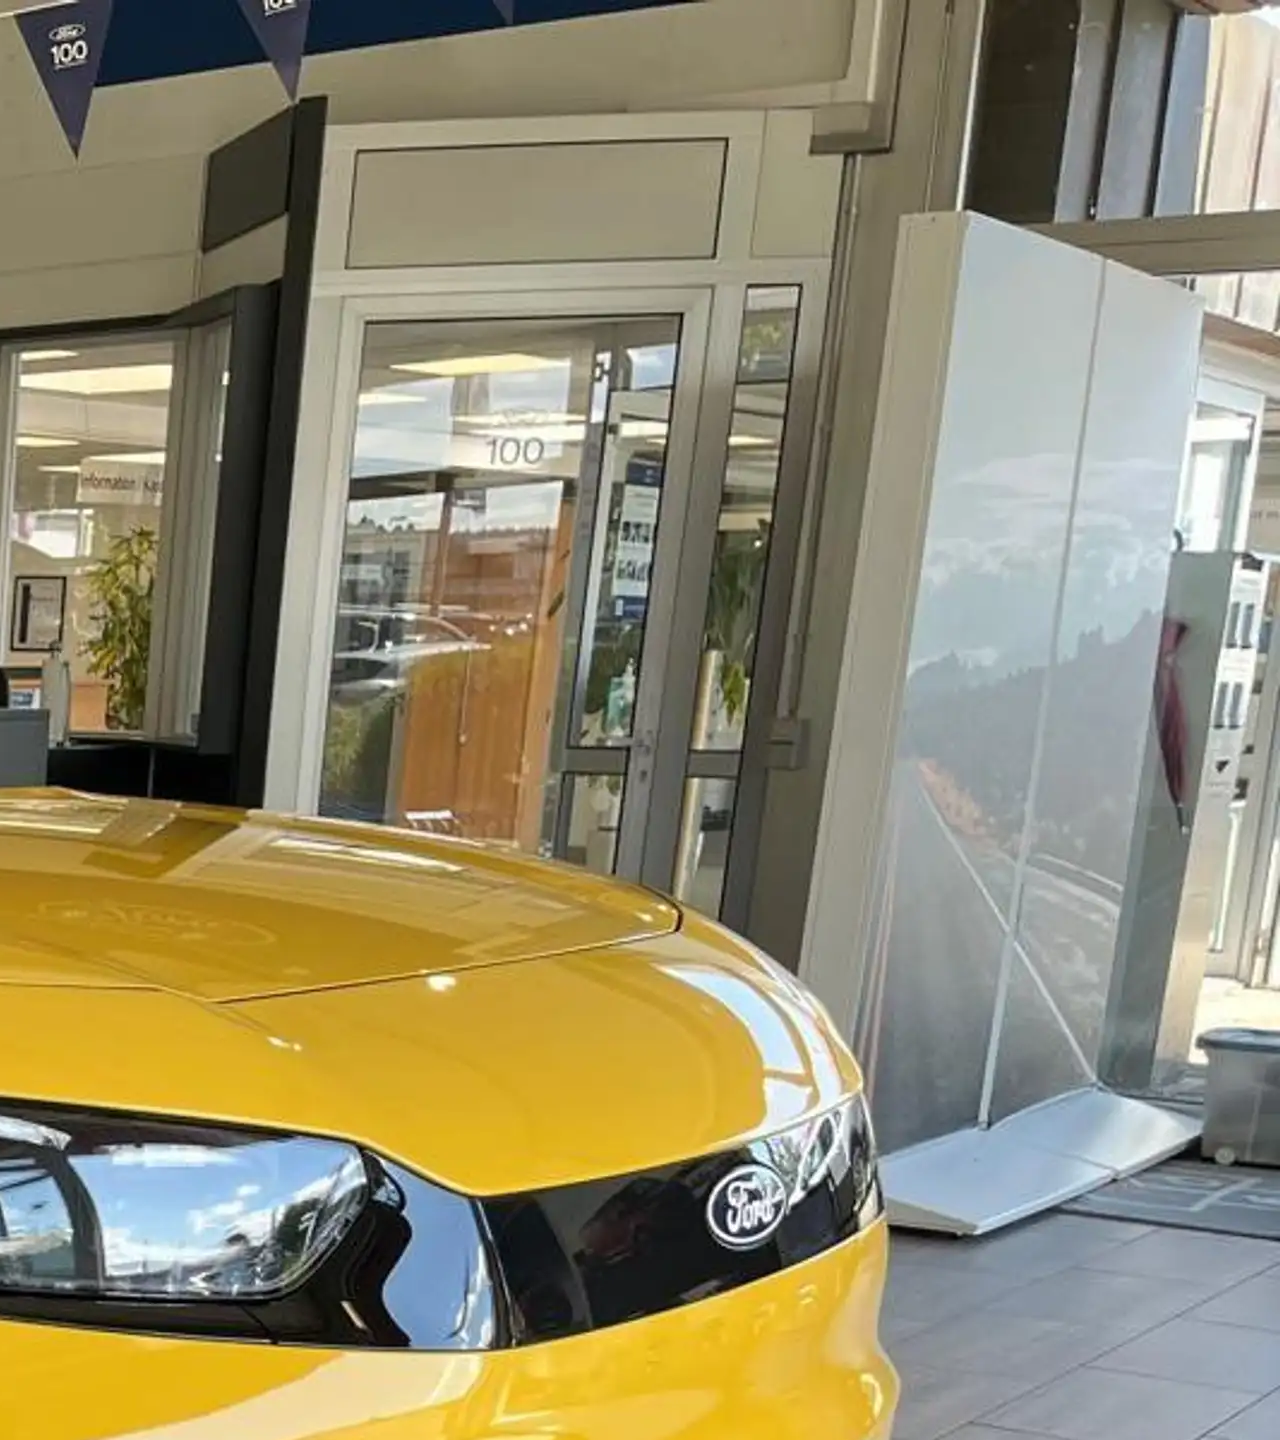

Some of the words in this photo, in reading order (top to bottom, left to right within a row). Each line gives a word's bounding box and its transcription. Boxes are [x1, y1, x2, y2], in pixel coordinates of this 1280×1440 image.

[50, 40, 88, 65] 100
[486, 437, 544, 465] 100
[725, 1174, 783, 1234] Ford
